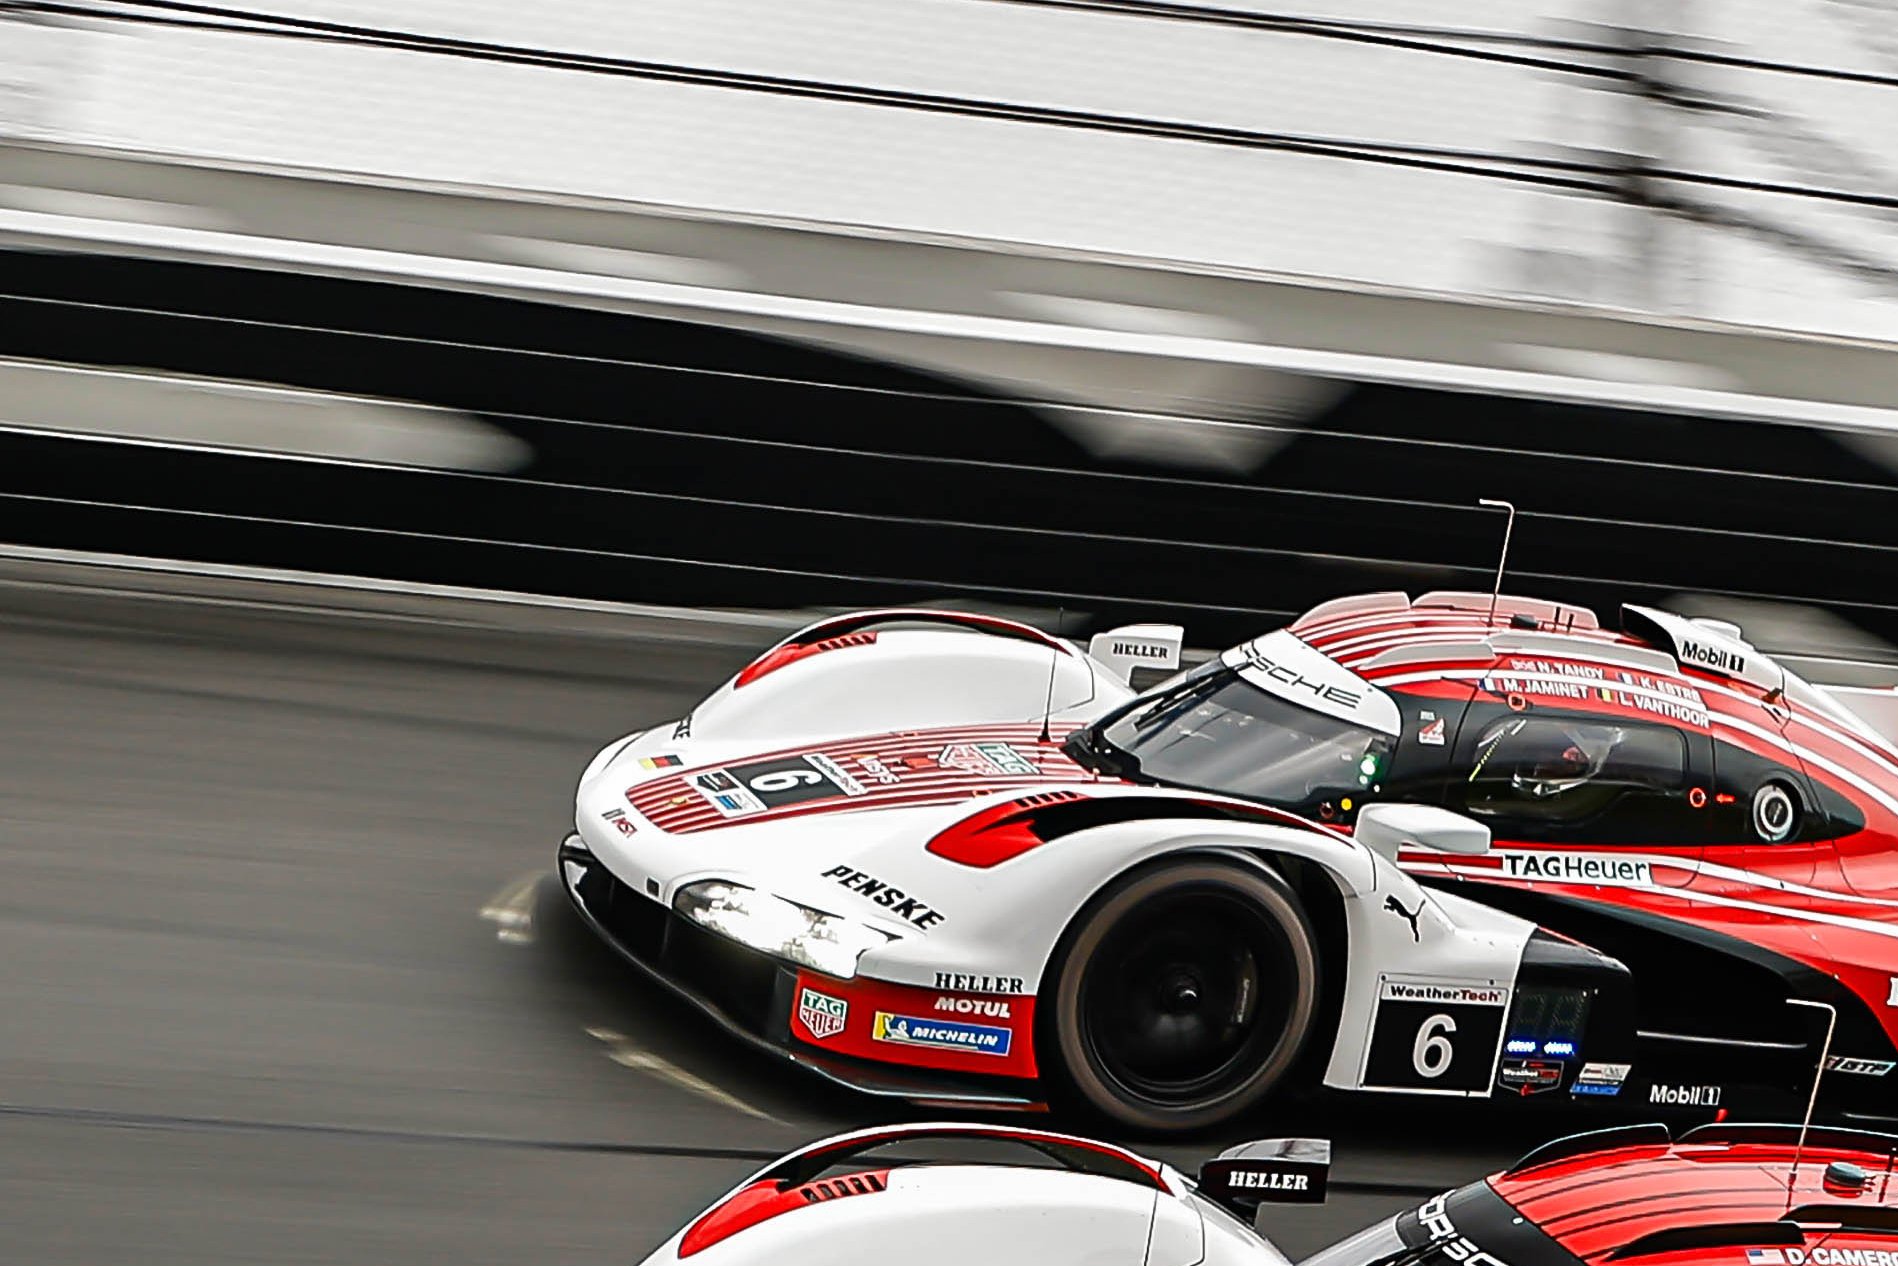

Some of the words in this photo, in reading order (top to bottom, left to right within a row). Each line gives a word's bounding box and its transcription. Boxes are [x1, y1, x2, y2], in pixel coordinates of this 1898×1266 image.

[1112, 642, 1168, 660] HELLER
[1682, 640, 1728, 669] Mobil
[1525, 680, 1588, 699] JAMINET
[1633, 695, 1710, 729] VANTHOOR
[750, 769, 822, 792] 6
[820, 864, 945, 930] PENSKE
[934, 972, 1024, 993] HELLER
[805, 992, 842, 1016] TAG
[1390, 985, 1498, 1003] WeatherTech
[934, 997, 1012, 1018] MOTUL
[912, 1027, 998, 1047] MICHELIN
[1413, 1013, 1457, 1078] 6
[1649, 1084, 1700, 1105] Mobil
[1228, 1170, 1309, 1191] HELLER
